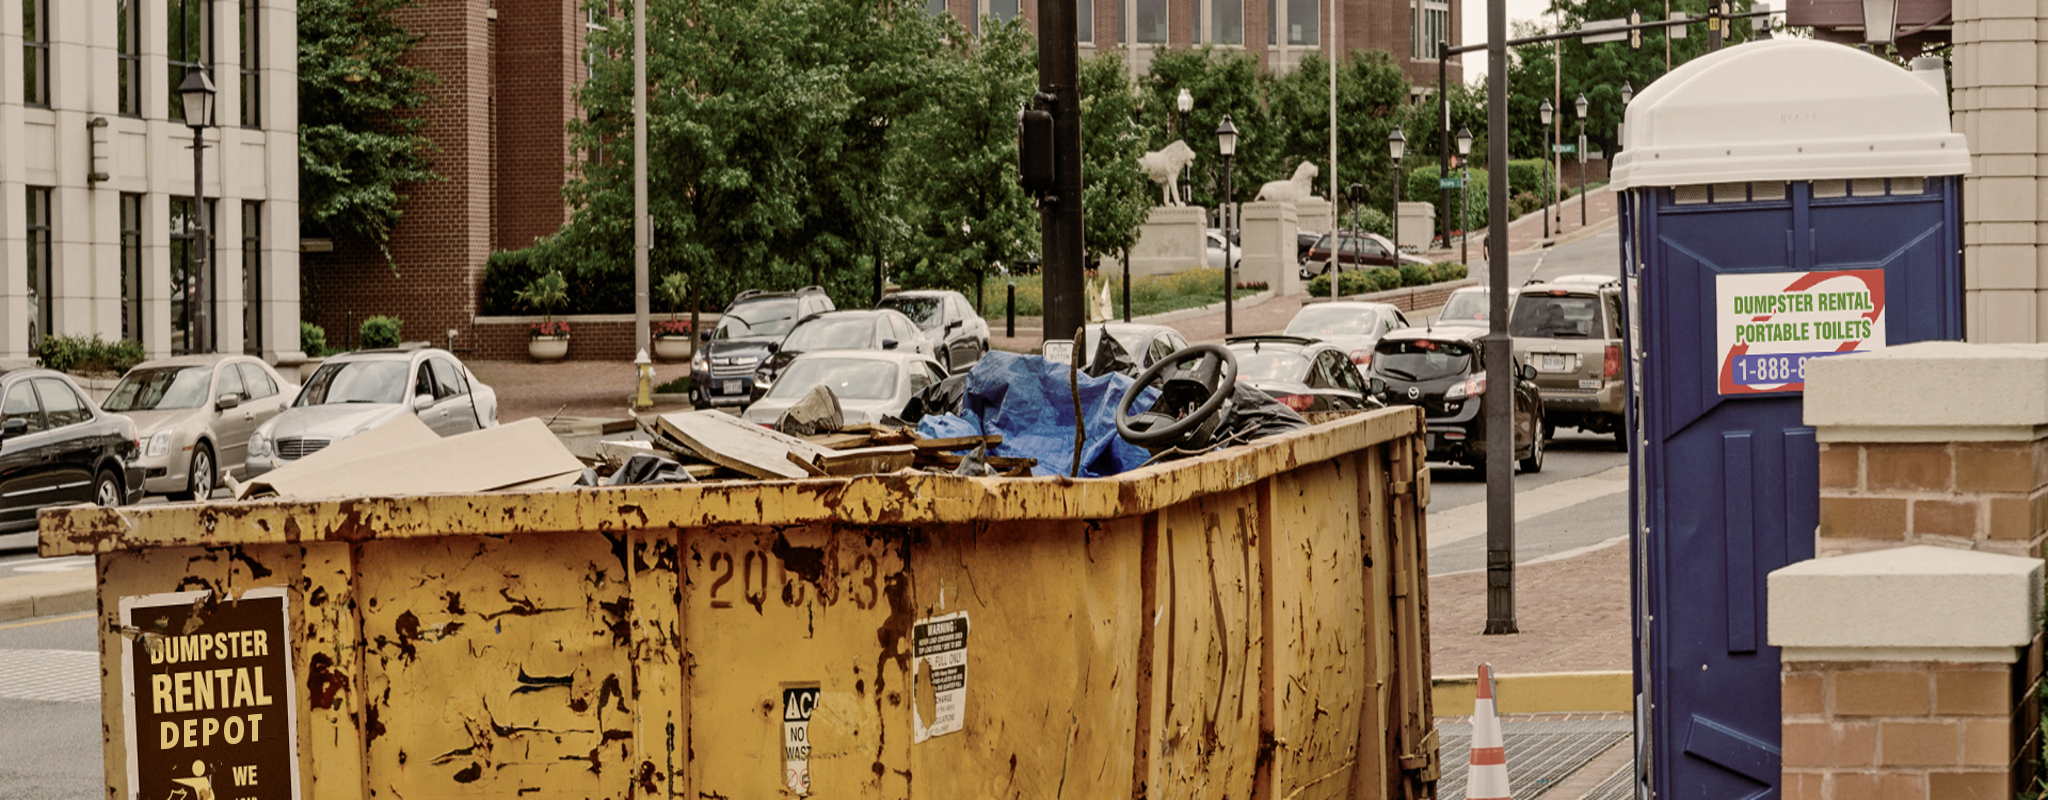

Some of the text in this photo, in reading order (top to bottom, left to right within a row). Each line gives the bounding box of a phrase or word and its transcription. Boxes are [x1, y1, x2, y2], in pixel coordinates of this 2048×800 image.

[1734, 291, 1873, 315] DUMPSTER RENTAL
[1736, 320, 1871, 343] PORTABLE TOILETS
[927, 620, 954, 637] WARNING
[150, 629, 269, 665] DUMPSTER
[935, 655, 948, 667] FULL
[949, 652, 961, 665] ONLY
[152, 666, 273, 714] RENTAL
[160, 713, 263, 750] DEPOT
[790, 726, 805, 742] NO
[232, 764, 258, 787] WE
